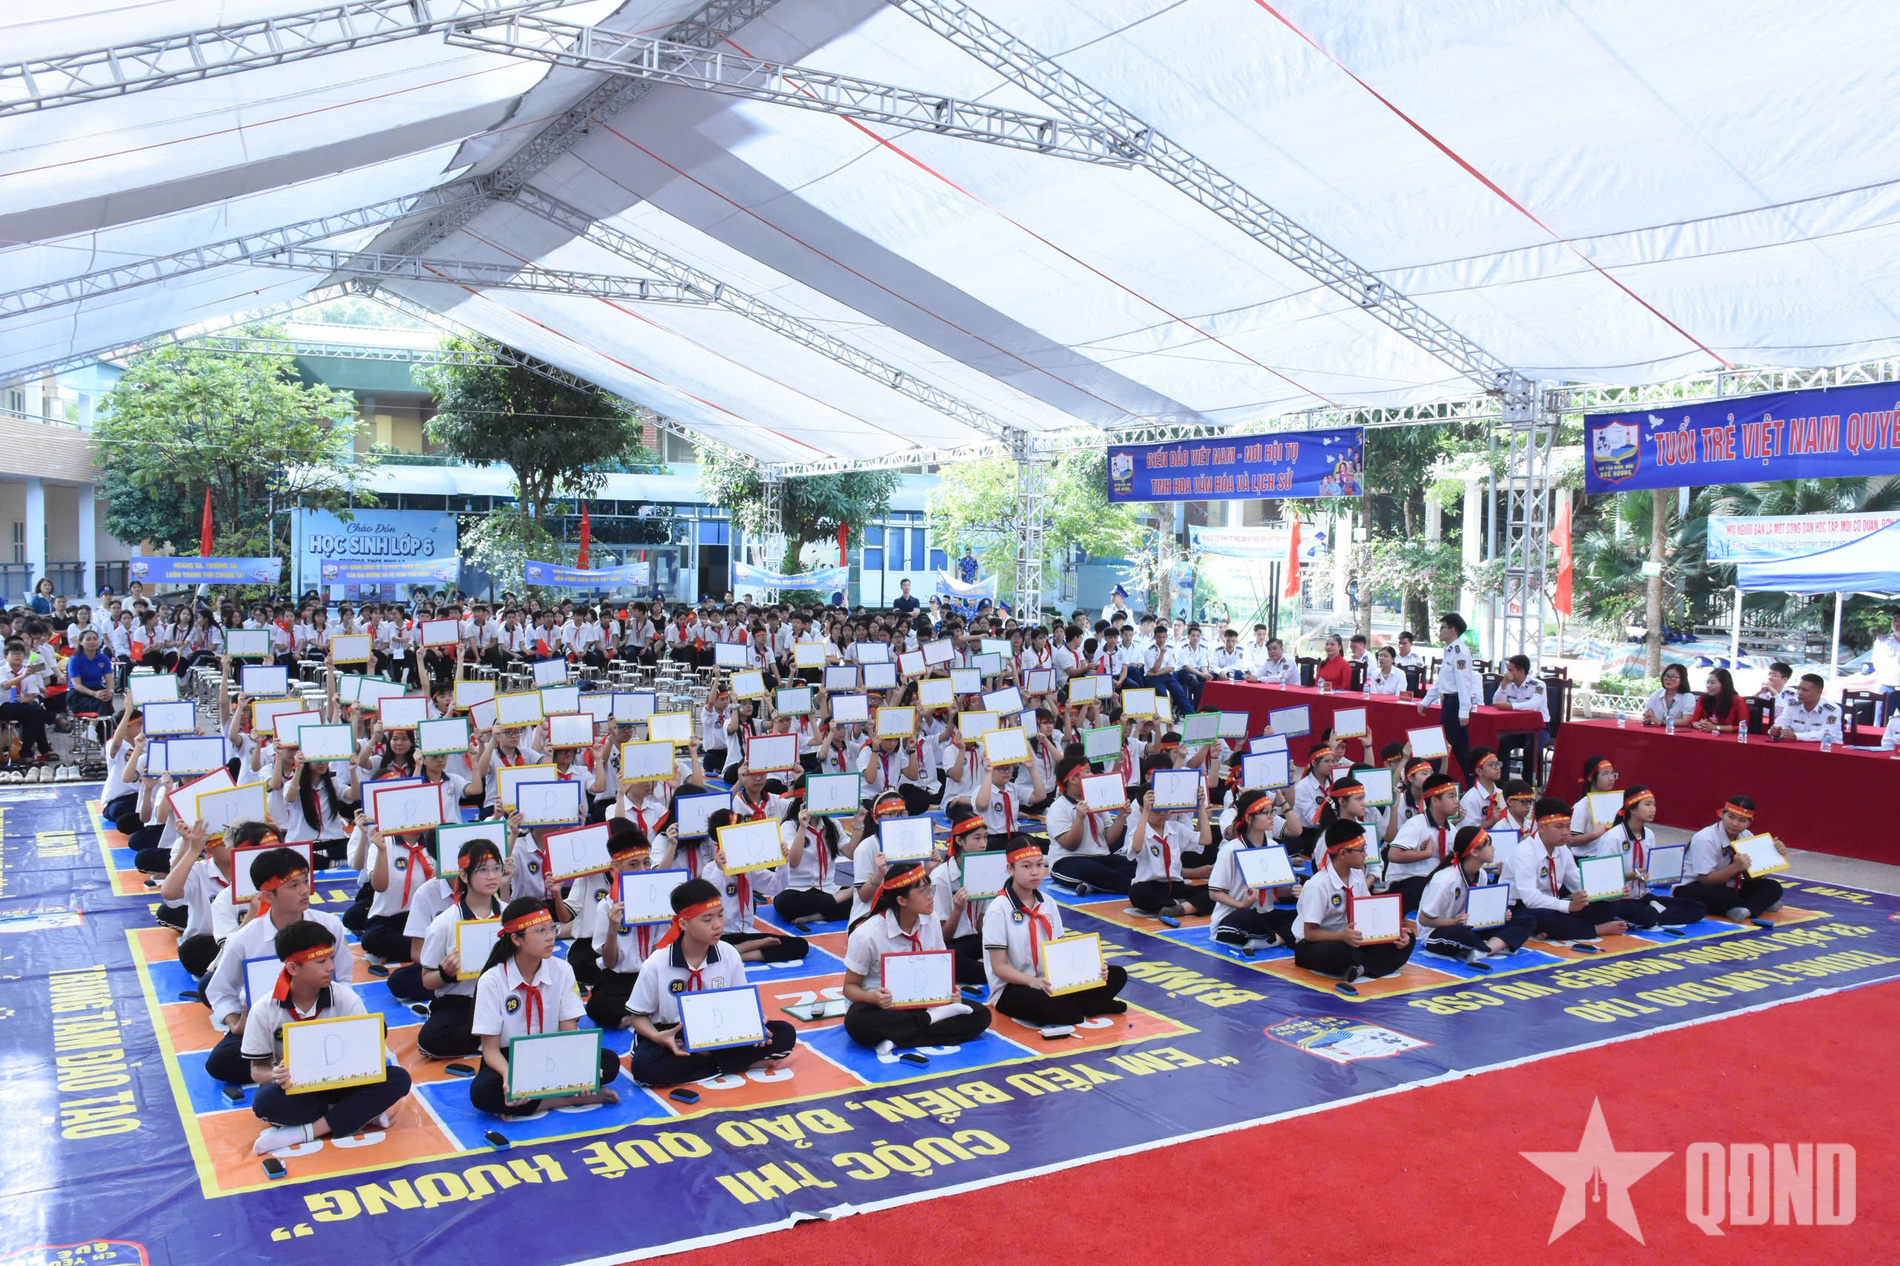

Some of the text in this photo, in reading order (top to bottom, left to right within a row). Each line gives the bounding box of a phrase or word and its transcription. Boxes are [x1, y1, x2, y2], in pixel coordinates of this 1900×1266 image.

[1654, 415, 1697, 466] TUỔI
[1701, 413, 1736, 463] TRẺ
[1741, 413, 1784, 465] VIỆT
[1788, 415, 1839, 455] NAM
[1212, 446, 1235, 464] NAM
[1244, 443, 1262, 463] NƠI
[1264, 441, 1283, 465] HỘI
[1285, 442, 1299, 465] TỤ
[1151, 466, 1294, 495] TINH HOA VĂN HÓA VÀ LỊCH SỬ
[347, 523, 396, 534] Chào Đón
[309, 532, 434, 558] HỌC SINH LỚP 6
[830, 786, 838, 801] D
[1170, 774, 1179, 795] D
[544, 790, 558, 811] D
[570, 835, 587, 862] D
[746, 830, 764, 858] D
[1260, 858, 1269, 873] D
[1792, 949, 1899, 978] TRUNG
[48, 964, 113, 1014] TRUNG
[672, 982, 682, 992] 28
[1482, 981, 1564, 1001] VỤ
[1636, 981, 1733, 1006] ĐÀO
[507, 999, 517, 1011] 29
[1408, 991, 1505, 1015] CSB
[1563, 997, 1661, 1023] TẠO
[712, 1007, 724, 1029] D
[53, 1010, 132, 1053] TÂM
[324, 1033, 345, 1066] D
[56, 1048, 142, 1092] ĐÀO
[545, 1057, 555, 1074] D
[1006, 1064, 1119, 1098] YÊU
[846, 1081, 1014, 1122] BIỂN,
[717, 1109, 853, 1149] ĐẢO
[583, 1131, 713, 1178] QUÊ
[716, 1129, 1010, 1204] CUỘC THI
